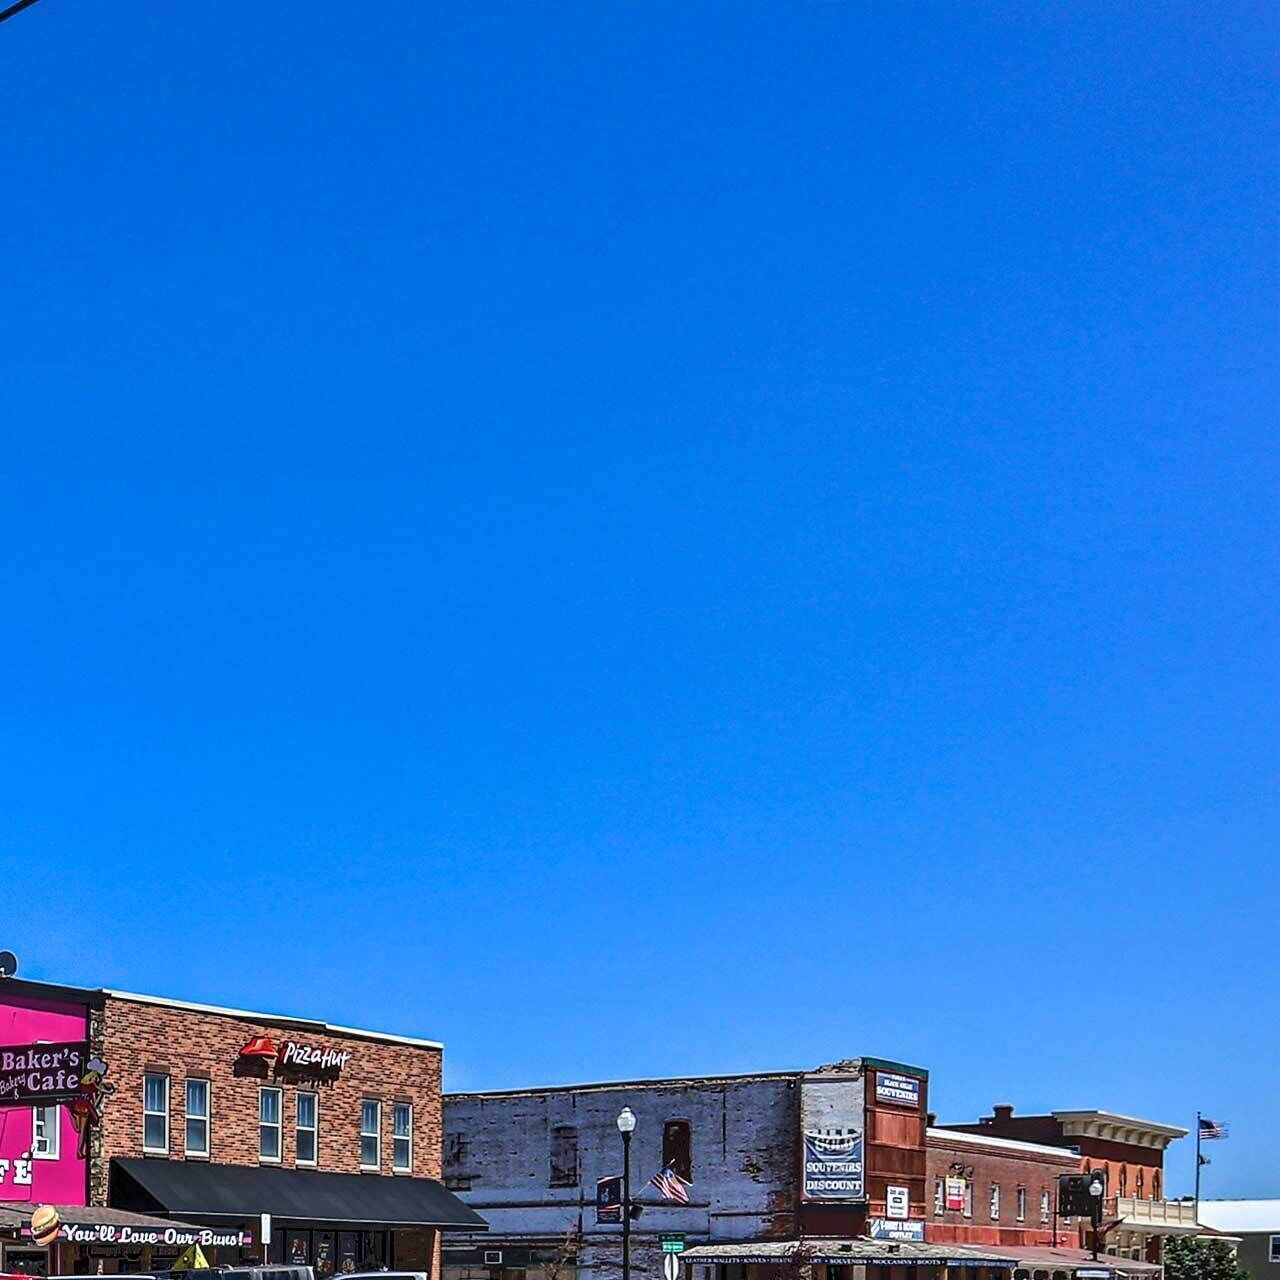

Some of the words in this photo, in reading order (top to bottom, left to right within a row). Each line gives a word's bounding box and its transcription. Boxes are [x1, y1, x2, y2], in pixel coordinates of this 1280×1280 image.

[1, 1048, 80, 1071] Baker's
[283, 1042, 321, 1065] Pizza
[320, 1047, 352, 1071] Hut
[0, 1073, 26, 1095] Bakery
[27, 1070, 79, 1092] Cafe
[876, 1085, 918, 1101] SOUVENIRS
[806, 1162, 862, 1173] SOUVENIRS
[806, 1180, 861, 1191] DISCOUNT
[62, 1224, 116, 1241] You'll
[118, 1227, 158, 1243] Love
[164, 1228, 194, 1244] Our
[199, 1230, 244, 1246] Buns!
